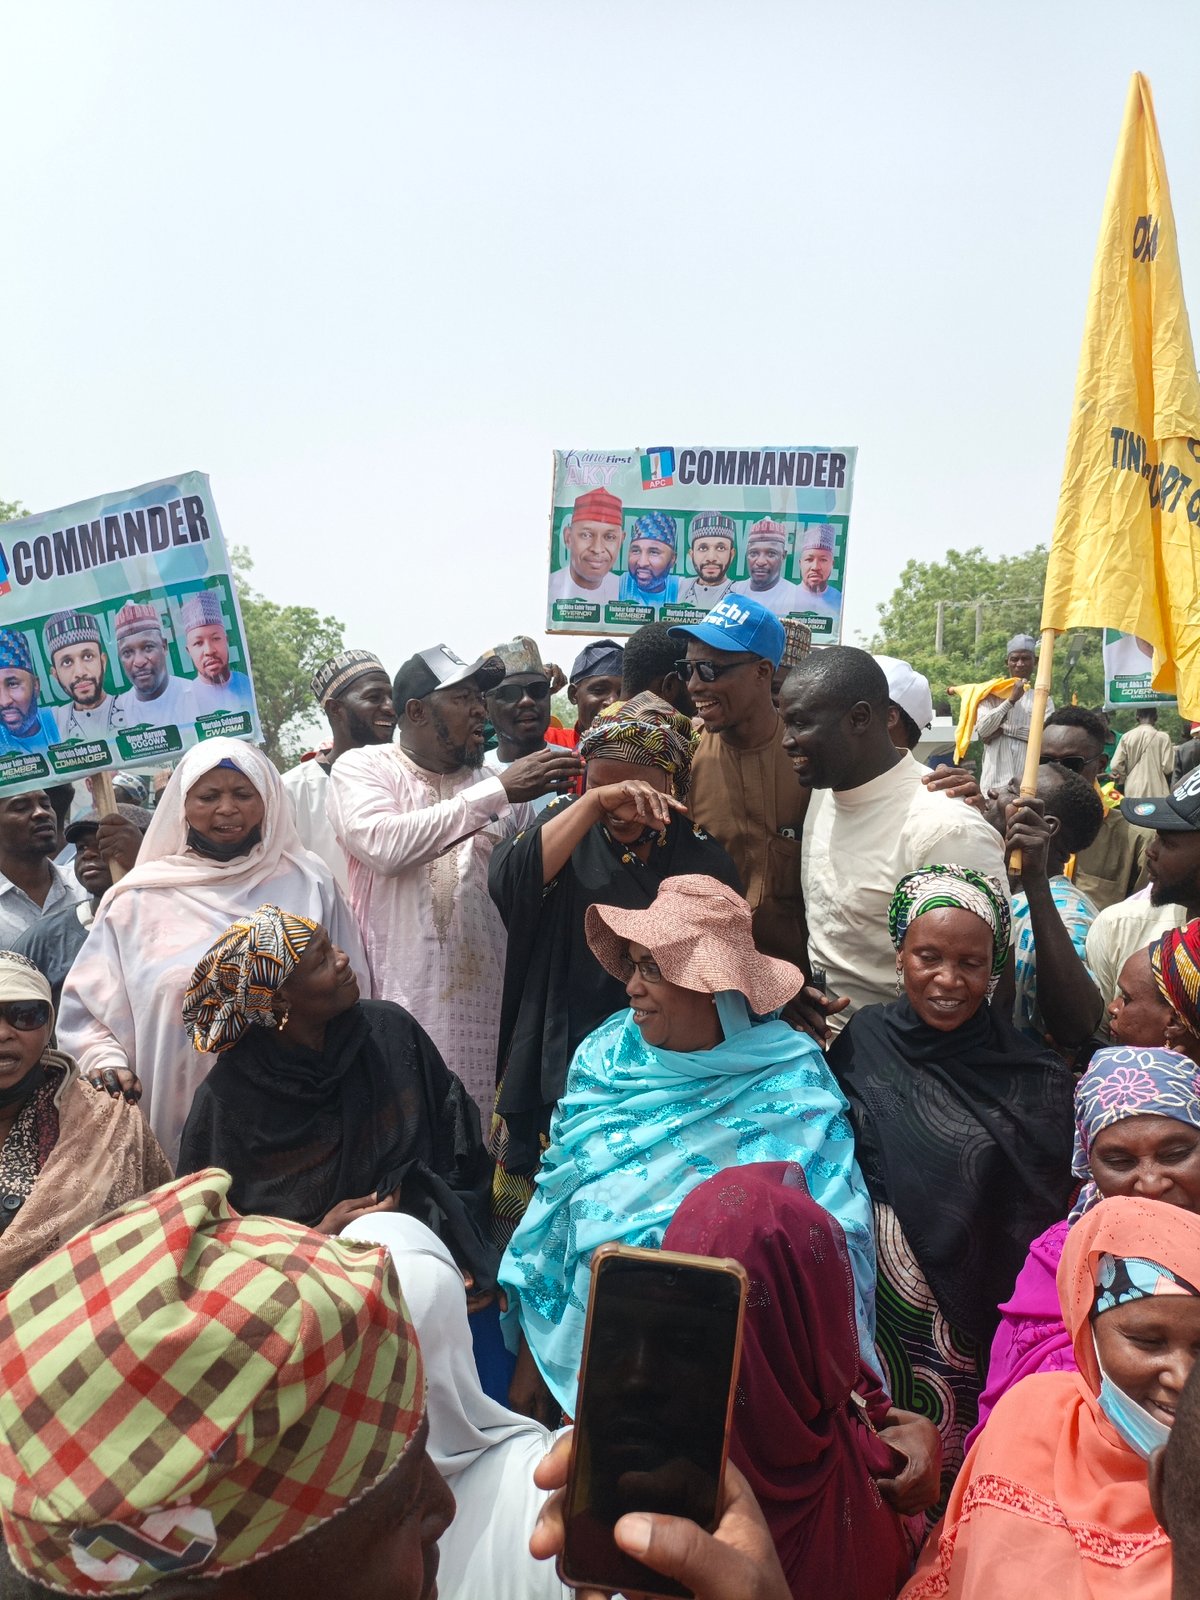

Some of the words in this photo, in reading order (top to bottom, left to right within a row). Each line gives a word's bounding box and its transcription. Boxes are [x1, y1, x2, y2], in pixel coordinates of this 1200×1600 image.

[564, 449, 605, 469] Kano
[605, 455, 632, 464] First
[565, 465, 617, 486] AKY
[678, 450, 847, 488] COMMANDER
[649, 479, 666, 488] APC
[12, 495, 211, 586] COMMANDER
[126, 733, 143, 744] Umar
[205, 723, 244, 738] GWARMAI
[130, 736, 167, 750] DOGOWA
[54, 751, 107, 769] COMMANDER
[1, 763, 38, 776] MEMBER
